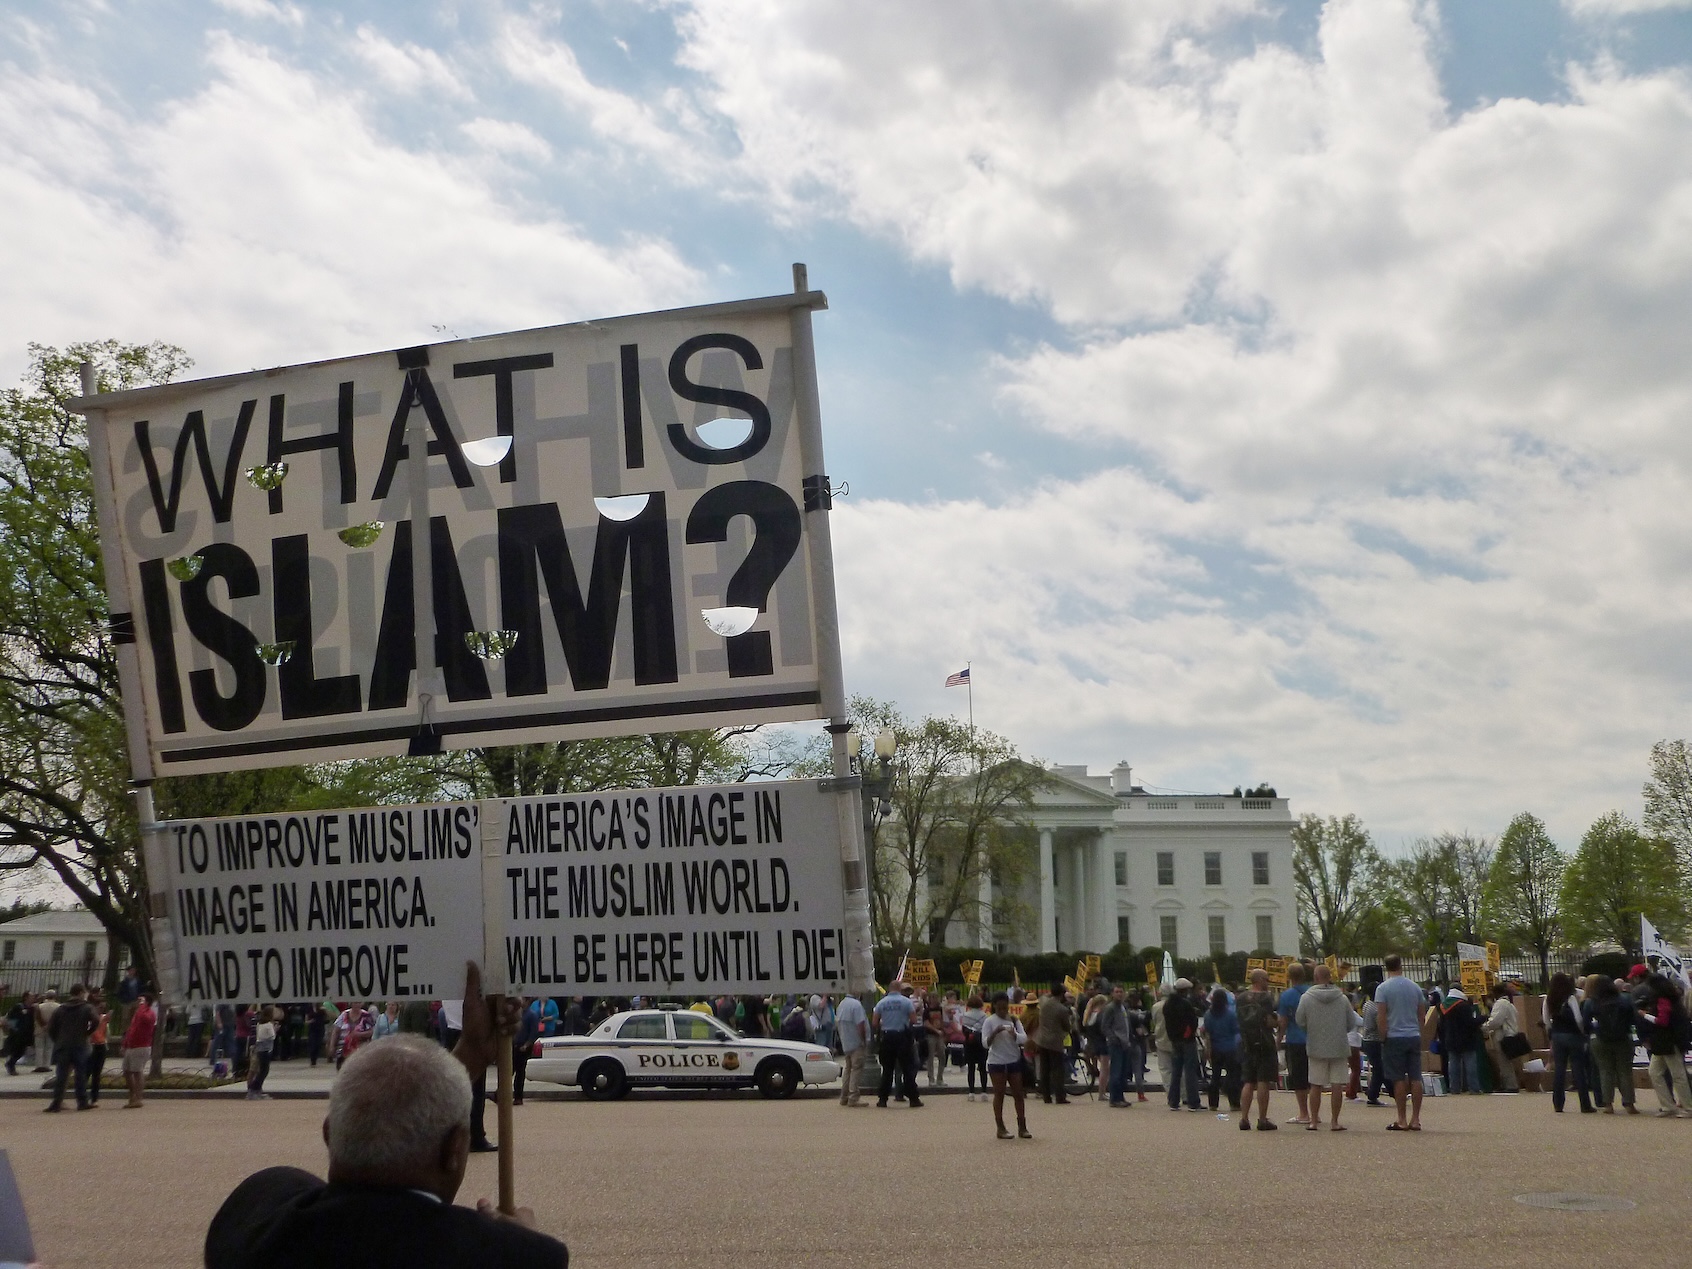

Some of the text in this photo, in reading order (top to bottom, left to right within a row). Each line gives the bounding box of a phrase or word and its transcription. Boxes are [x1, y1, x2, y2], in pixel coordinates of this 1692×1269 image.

[135, 332, 773, 533] WHAT IS
[139, 479, 802, 735] ISLAM?
[174, 824, 209, 874] TO
[215, 814, 341, 872] IMPROVE
[506, 790, 783, 854] AMERICA'S IMAGE IN
[178, 876, 436, 937] IMAGE IN AMERICA.
[507, 857, 799, 919] THE MUSLIM WORLD.
[186, 944, 434, 1000] AND TO IMPROVE...
[505, 936, 566, 984] WILL
[574, 934, 607, 983] BE
[615, 932, 685, 983] HERE
[693, 930, 770, 982] UNTIL
[777, 929, 785, 980] I
[792, 928, 846, 981] DIE!
[637, 1054, 720, 1067] POLICE
